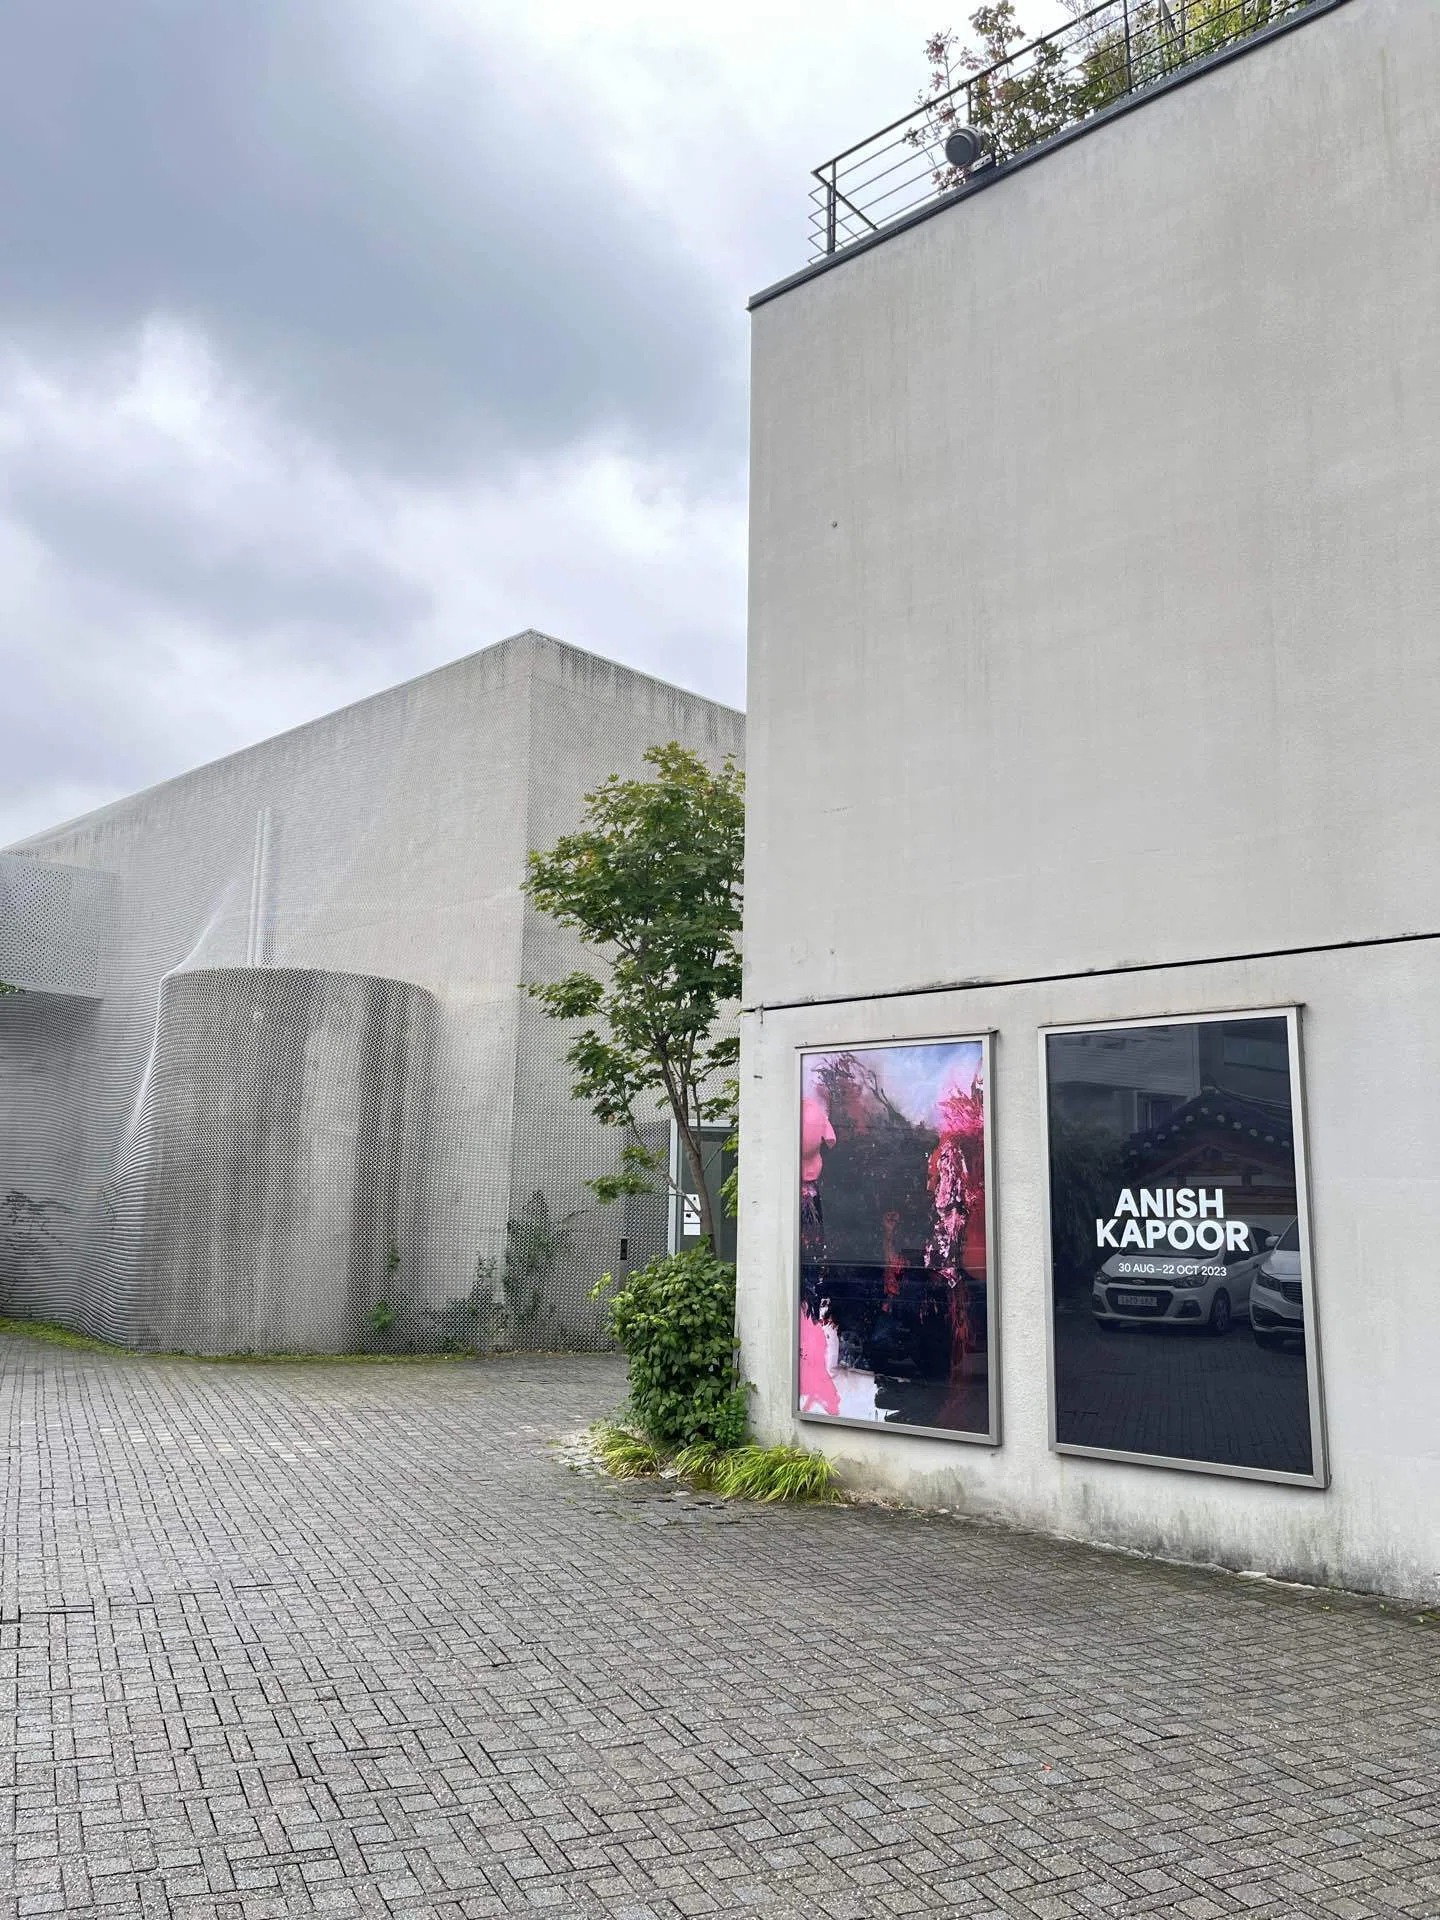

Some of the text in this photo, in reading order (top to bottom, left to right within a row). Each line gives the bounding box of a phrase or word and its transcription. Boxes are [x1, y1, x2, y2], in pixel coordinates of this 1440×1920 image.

[1113, 1188, 1224, 1219] ANISH
[1096, 1218, 1250, 1252] KAPOOR
[1118, 1262, 1132, 1273] 30
[1176, 1264, 1200, 1275] OCT
[1201, 1265, 1227, 1277] 2023
